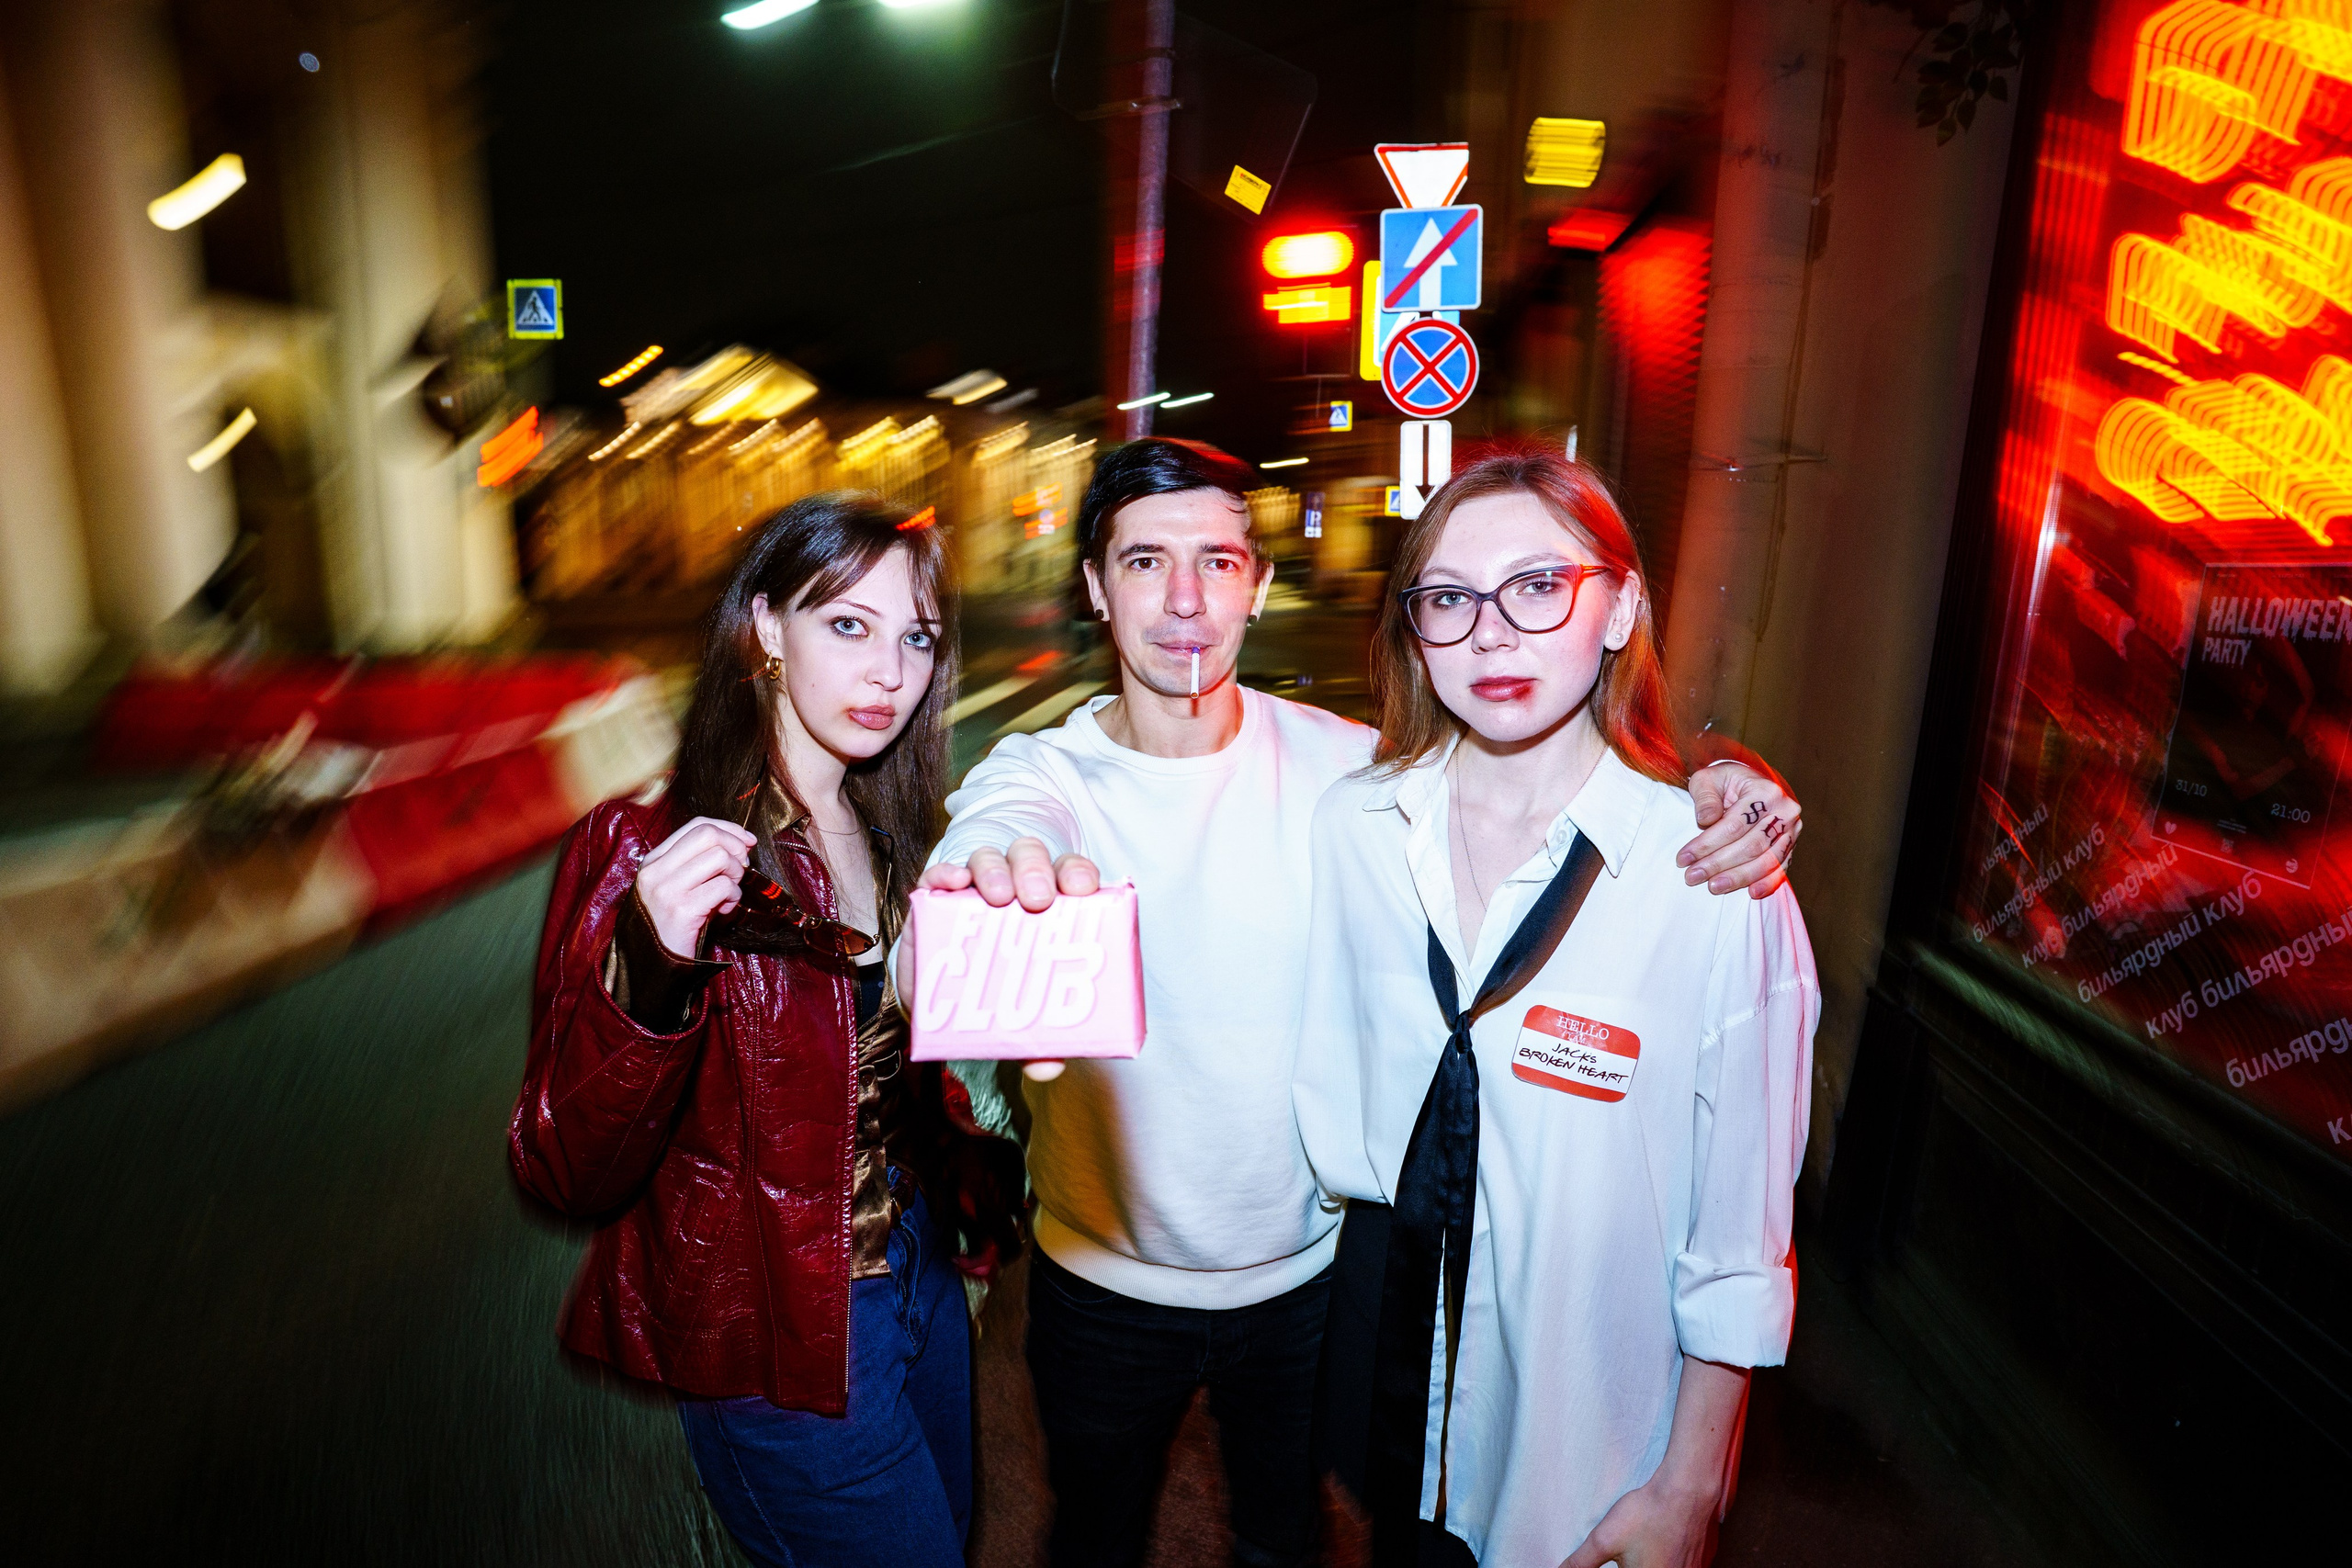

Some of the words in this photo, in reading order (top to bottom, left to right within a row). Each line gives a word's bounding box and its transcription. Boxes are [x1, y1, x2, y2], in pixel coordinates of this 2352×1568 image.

[2207, 596, 2352, 644] HALLOWEEN
[2201, 637, 2252, 666] PARTY
[2176, 779, 2208, 797] 31/10
[2270, 803, 2311, 824] 21:00
[1981, 802, 2049, 875] льярдный
[1973, 860, 2063, 942] бильярдный
[2063, 822, 2105, 871] клуб
[2061, 842, 2178, 939] бильярдный
[2077, 911, 2202, 1003] бильярдный
[2202, 872, 2262, 926] клуб
[917, 943, 1107, 1033] CLUB
[1556, 1016, 1610, 1040] HELLO
[2145, 990, 2199, 1039] клуб
[1519, 1047, 1576, 1070] BROKEN
[1577, 1064, 1629, 1084] HEART
